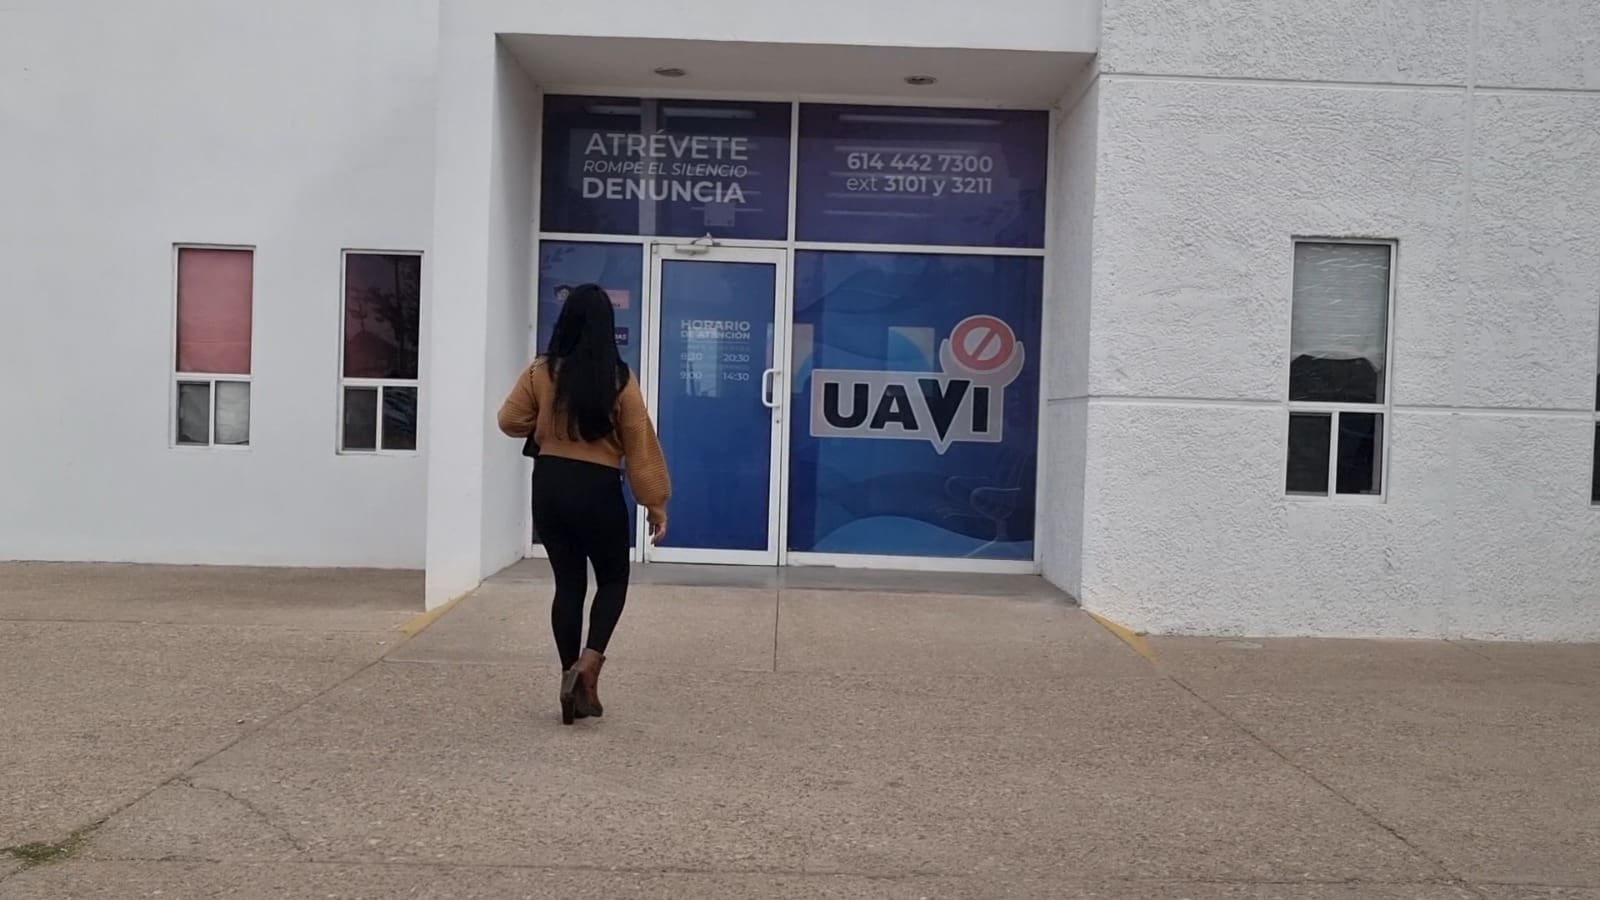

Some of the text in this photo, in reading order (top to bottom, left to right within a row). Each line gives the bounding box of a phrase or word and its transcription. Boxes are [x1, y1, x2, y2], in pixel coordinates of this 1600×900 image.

[584, 129, 748, 161] ATRÉVETE
[583, 160, 748, 178] ROMPE EL SILENCIO
[847, 152, 993, 173] 614 442 7300
[582, 177, 746, 204] DENUNCIA
[846, 175, 992, 197] ext 3101 y 3211
[680, 320, 751, 331] HORARIO
[823, 378, 990, 441] UAVI
